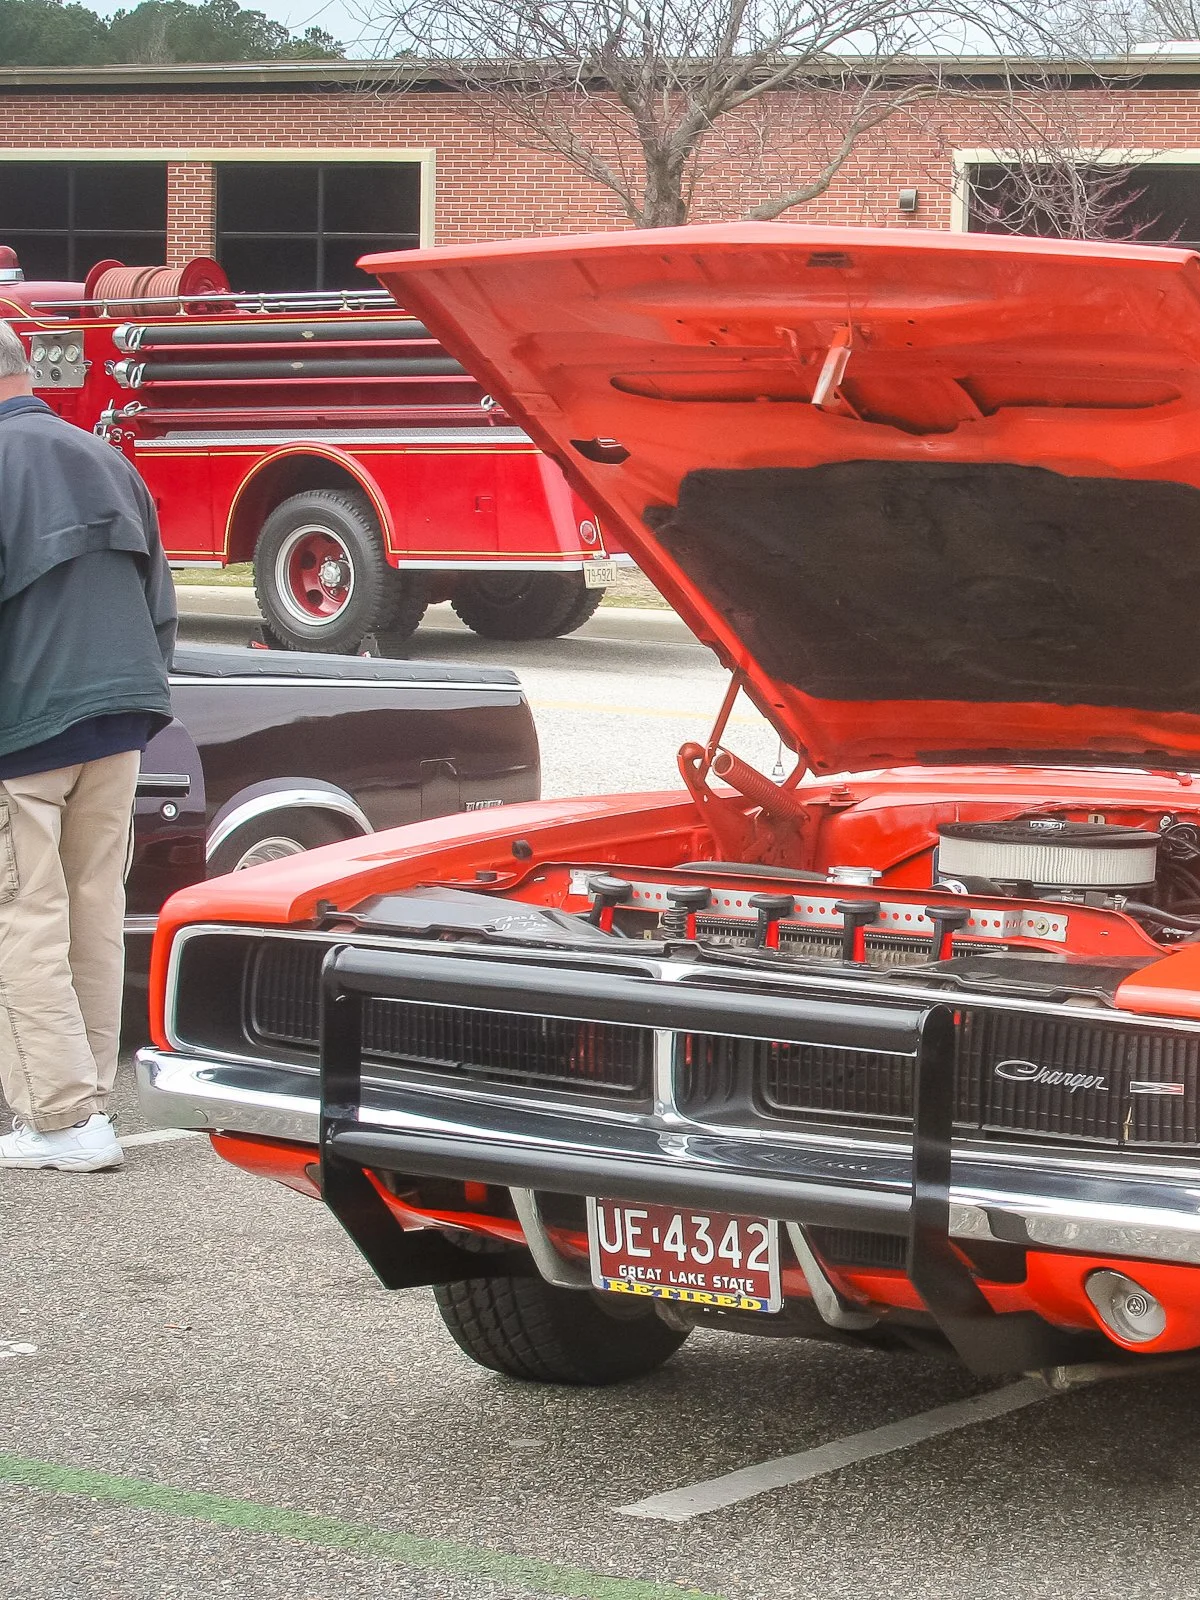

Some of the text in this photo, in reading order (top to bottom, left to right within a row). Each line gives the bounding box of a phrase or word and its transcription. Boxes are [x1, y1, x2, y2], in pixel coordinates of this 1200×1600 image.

[994, 1059, 1109, 1094] Charger
[606, 1278, 763, 1311] RETIRED
[618, 1264, 755, 1293] GREAT LAKE STATE
